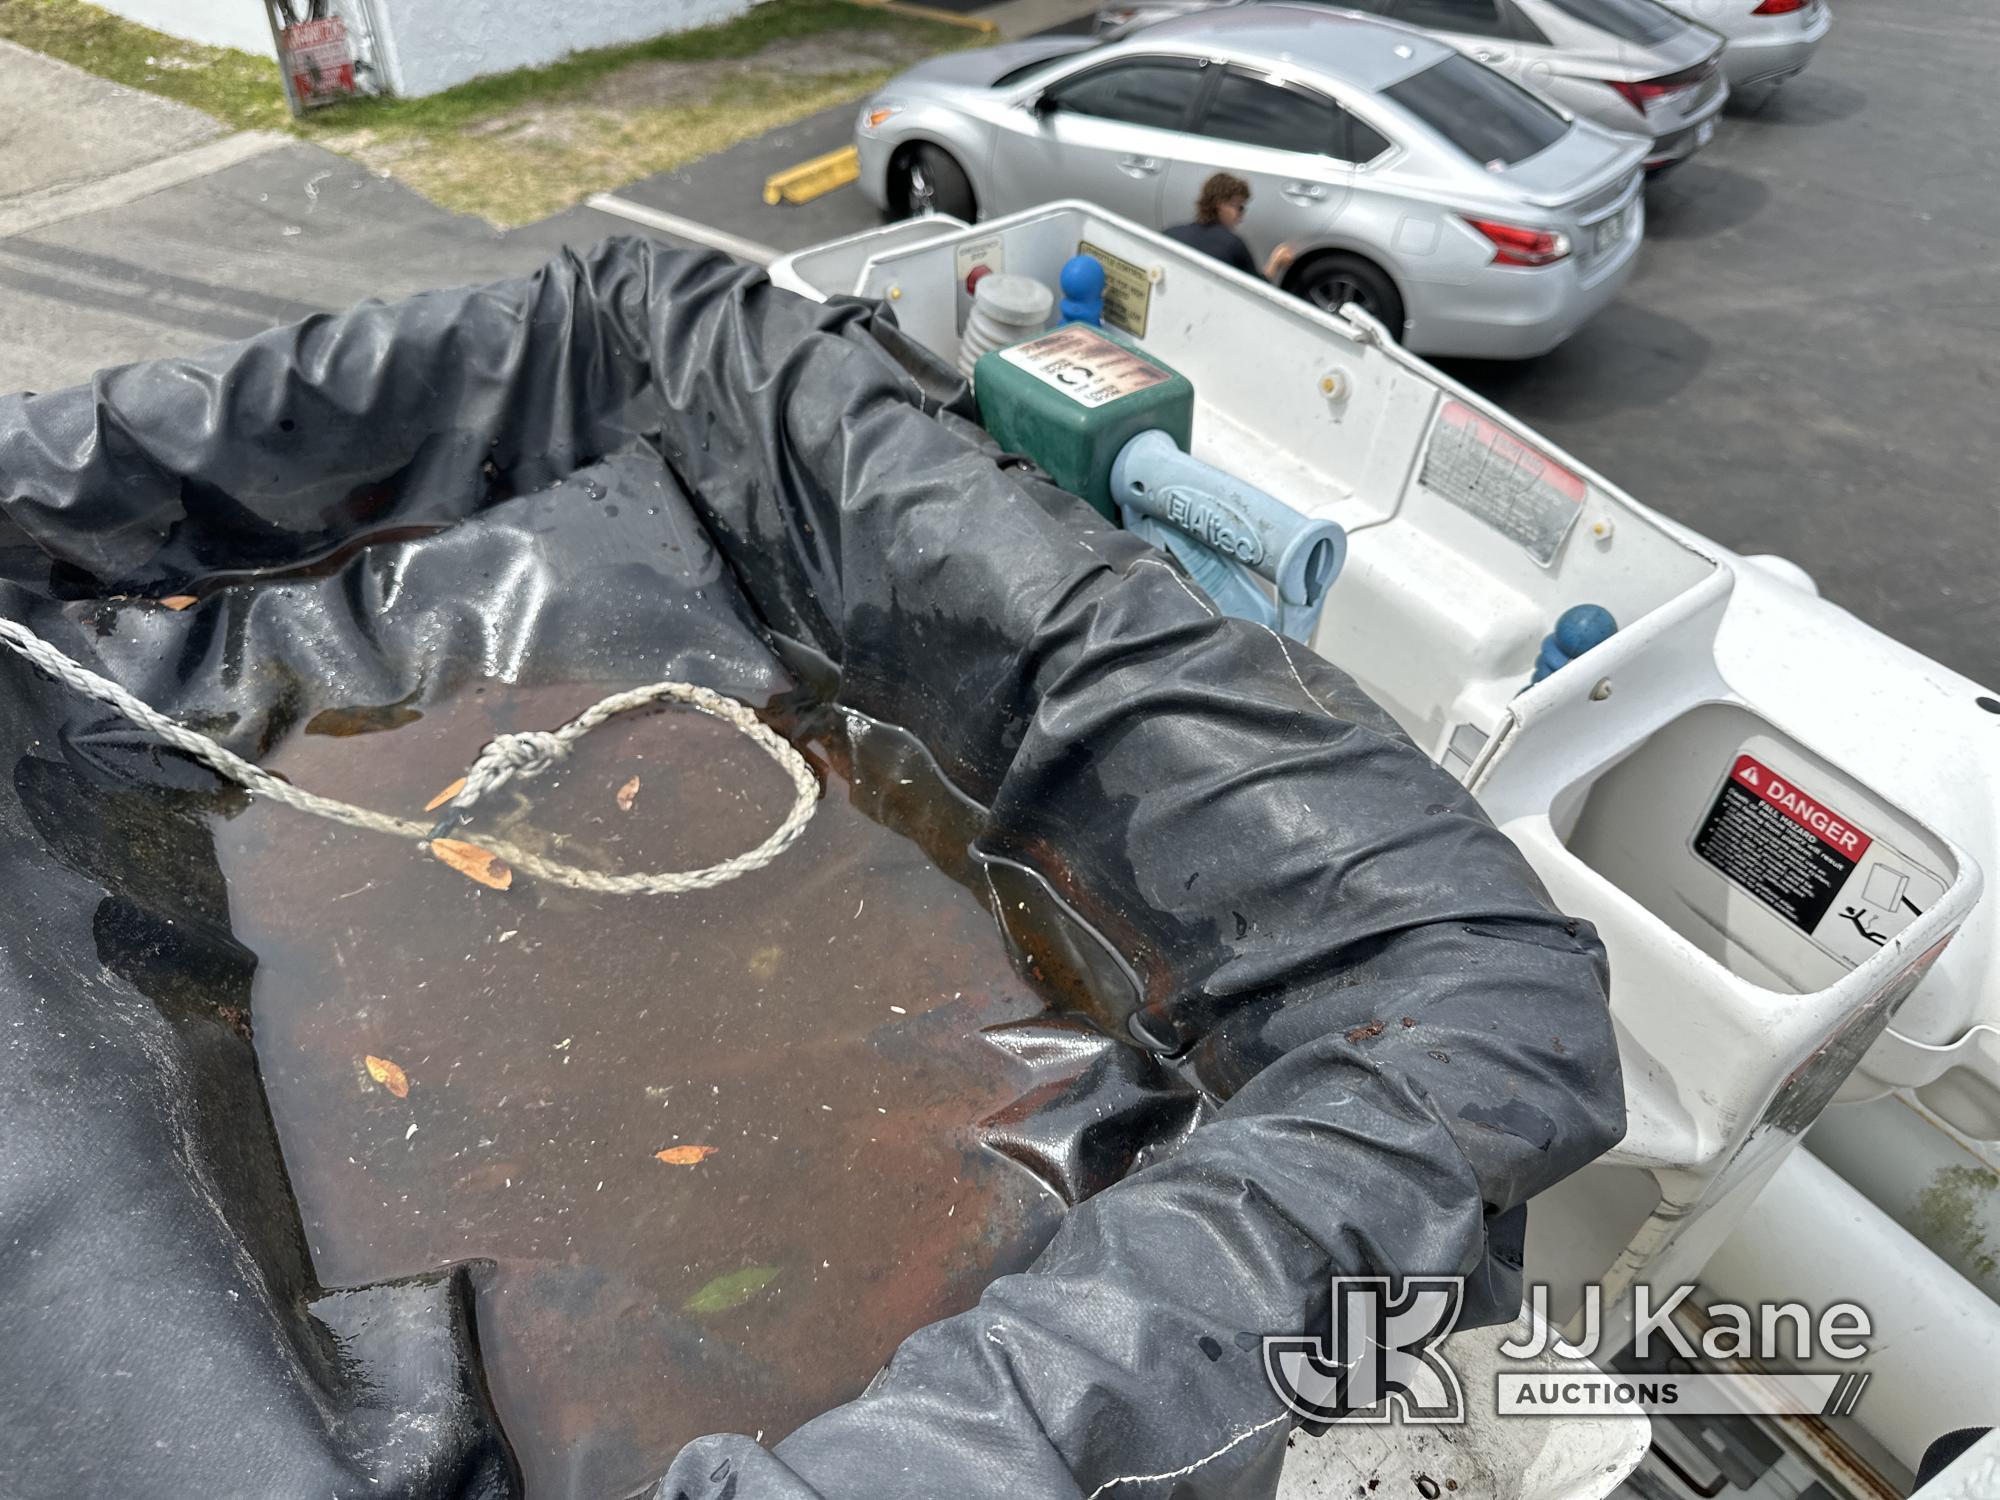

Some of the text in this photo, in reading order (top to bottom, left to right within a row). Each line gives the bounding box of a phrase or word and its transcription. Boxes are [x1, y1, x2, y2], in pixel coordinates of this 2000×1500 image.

[1190, 504, 1255, 562] Altec
[1758, 800, 1779, 818] FALL
[1779, 815, 1817, 844] HAZARD
[1766, 781, 1859, 851] DANGER
[1785, 828, 1806, 845] injury
[1807, 842, 1820, 854] will
[1820, 852, 1843, 870] result
